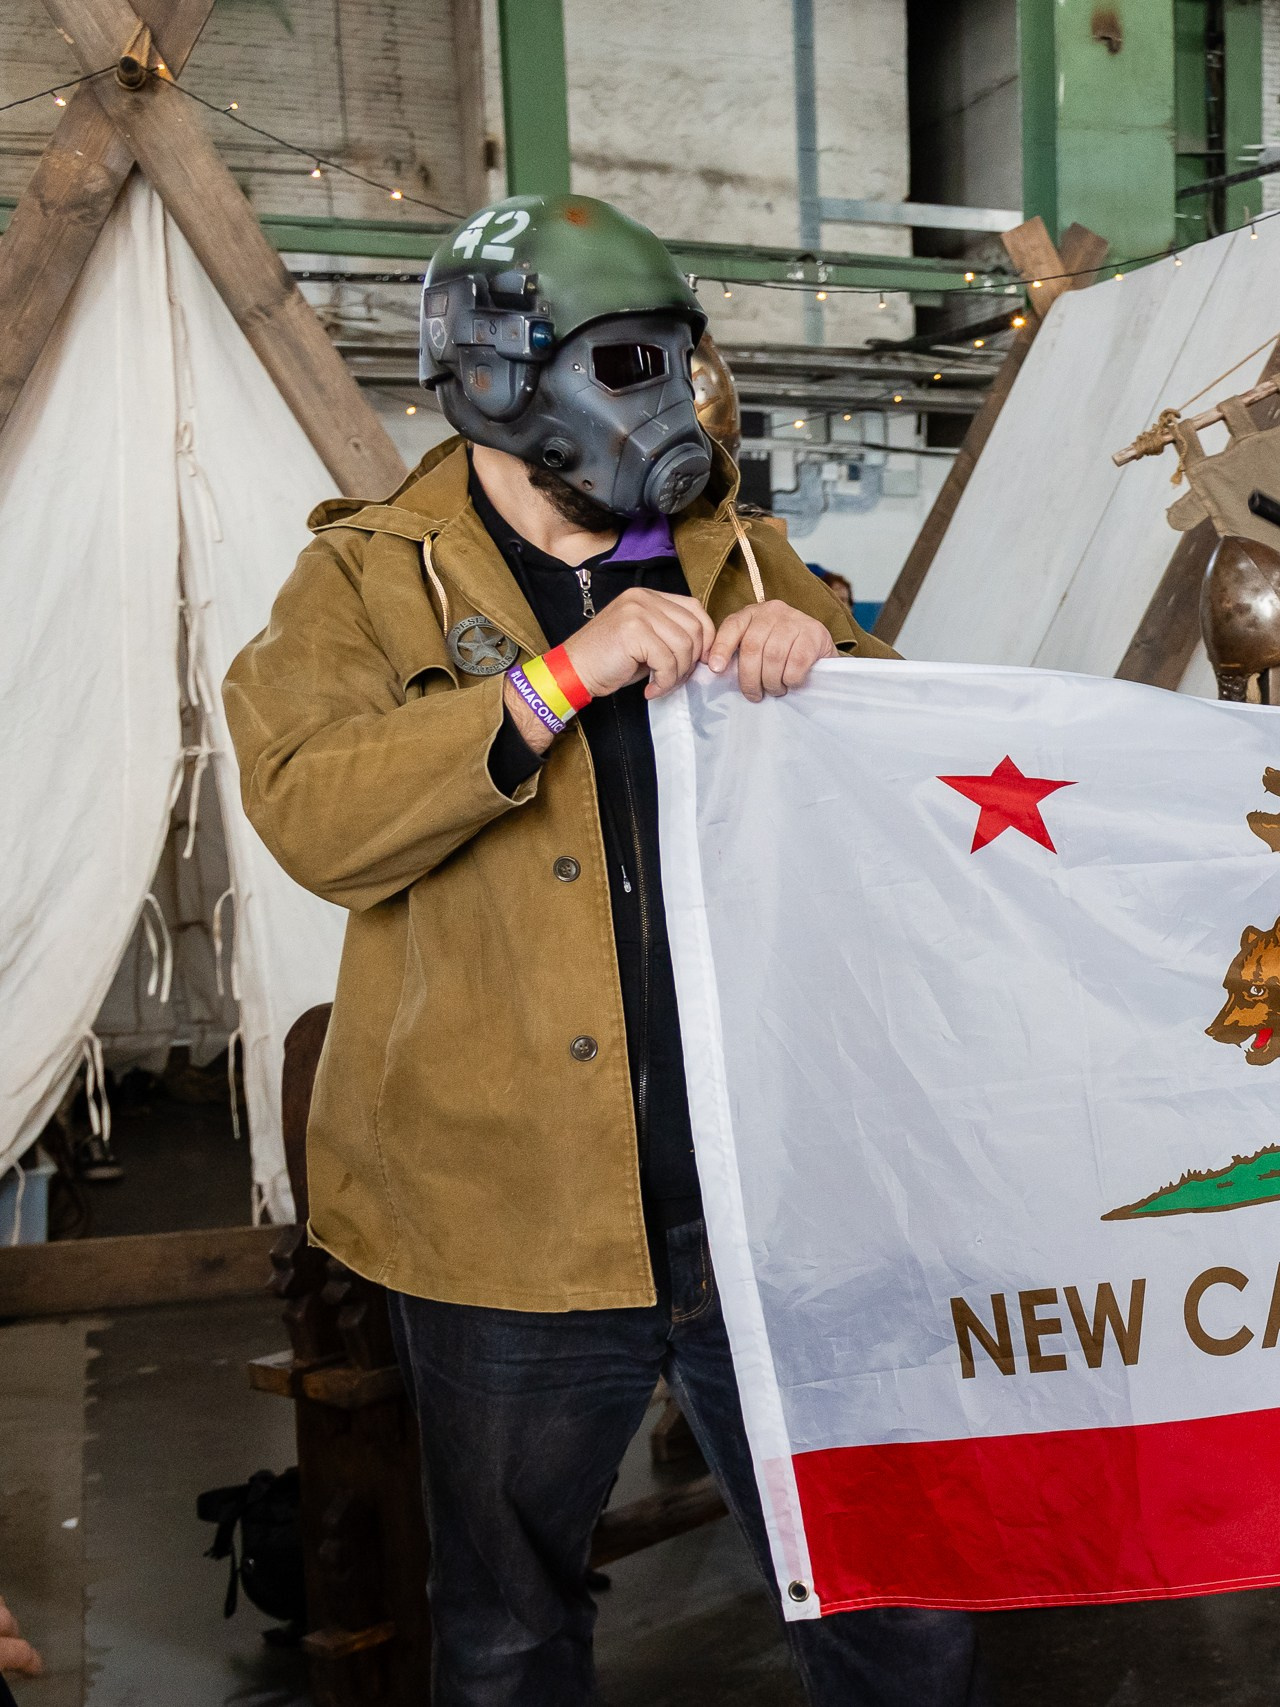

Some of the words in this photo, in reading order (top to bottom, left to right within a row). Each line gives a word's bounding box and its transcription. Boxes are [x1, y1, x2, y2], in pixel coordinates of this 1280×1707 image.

[453, 210, 530, 262] 42
[511, 670, 565, 734] #LAMACOMIC
[948, 1278, 1148, 1380] NEW
